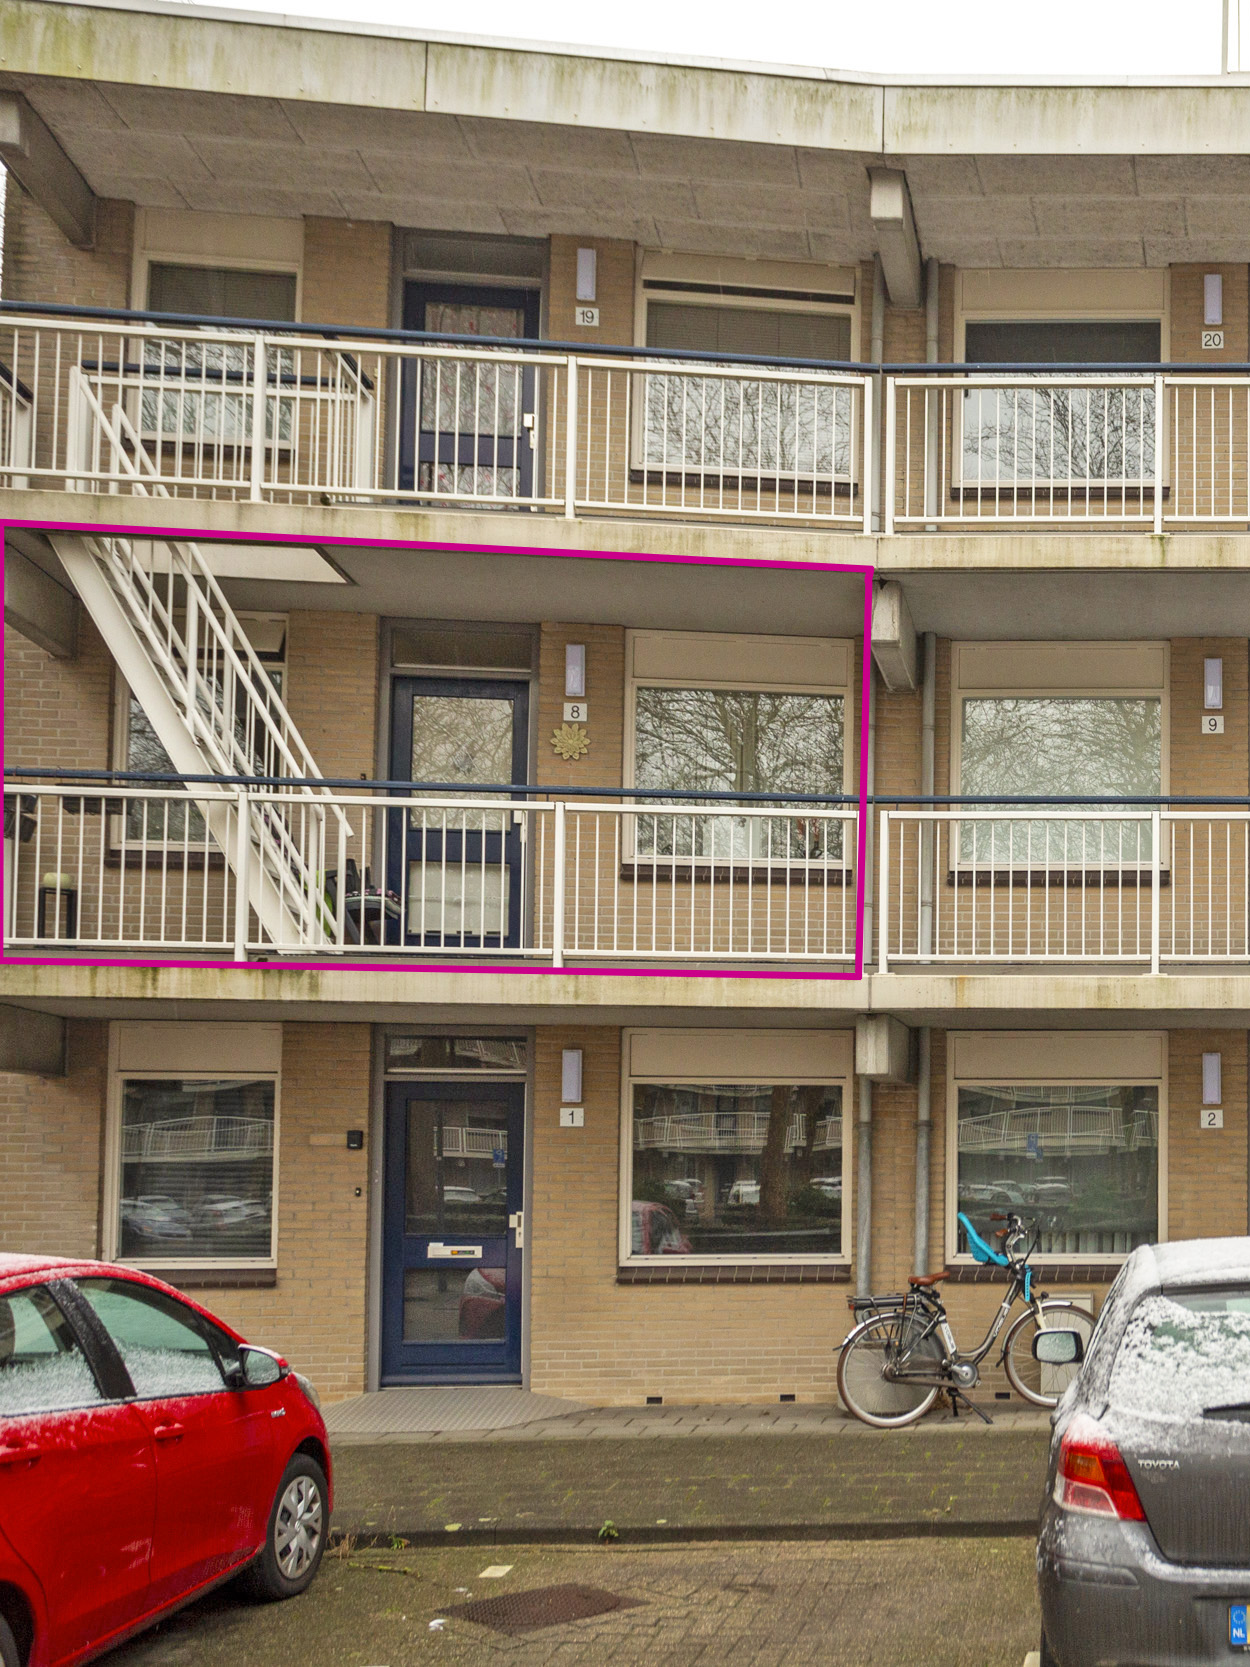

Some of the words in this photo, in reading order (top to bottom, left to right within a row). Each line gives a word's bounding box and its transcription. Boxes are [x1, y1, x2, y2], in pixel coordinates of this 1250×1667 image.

[580, 310, 594, 324] 19
[1204, 333, 1221, 347] 20
[571, 705, 580, 719] 8
[1209, 718, 1217, 731] 9
[568, 1111, 574, 1124] 1
[1208, 1112, 1216, 1126] 2
[1137, 1459, 1180, 1470] TOYOTA
[1232, 1628, 1245, 1638] NL
